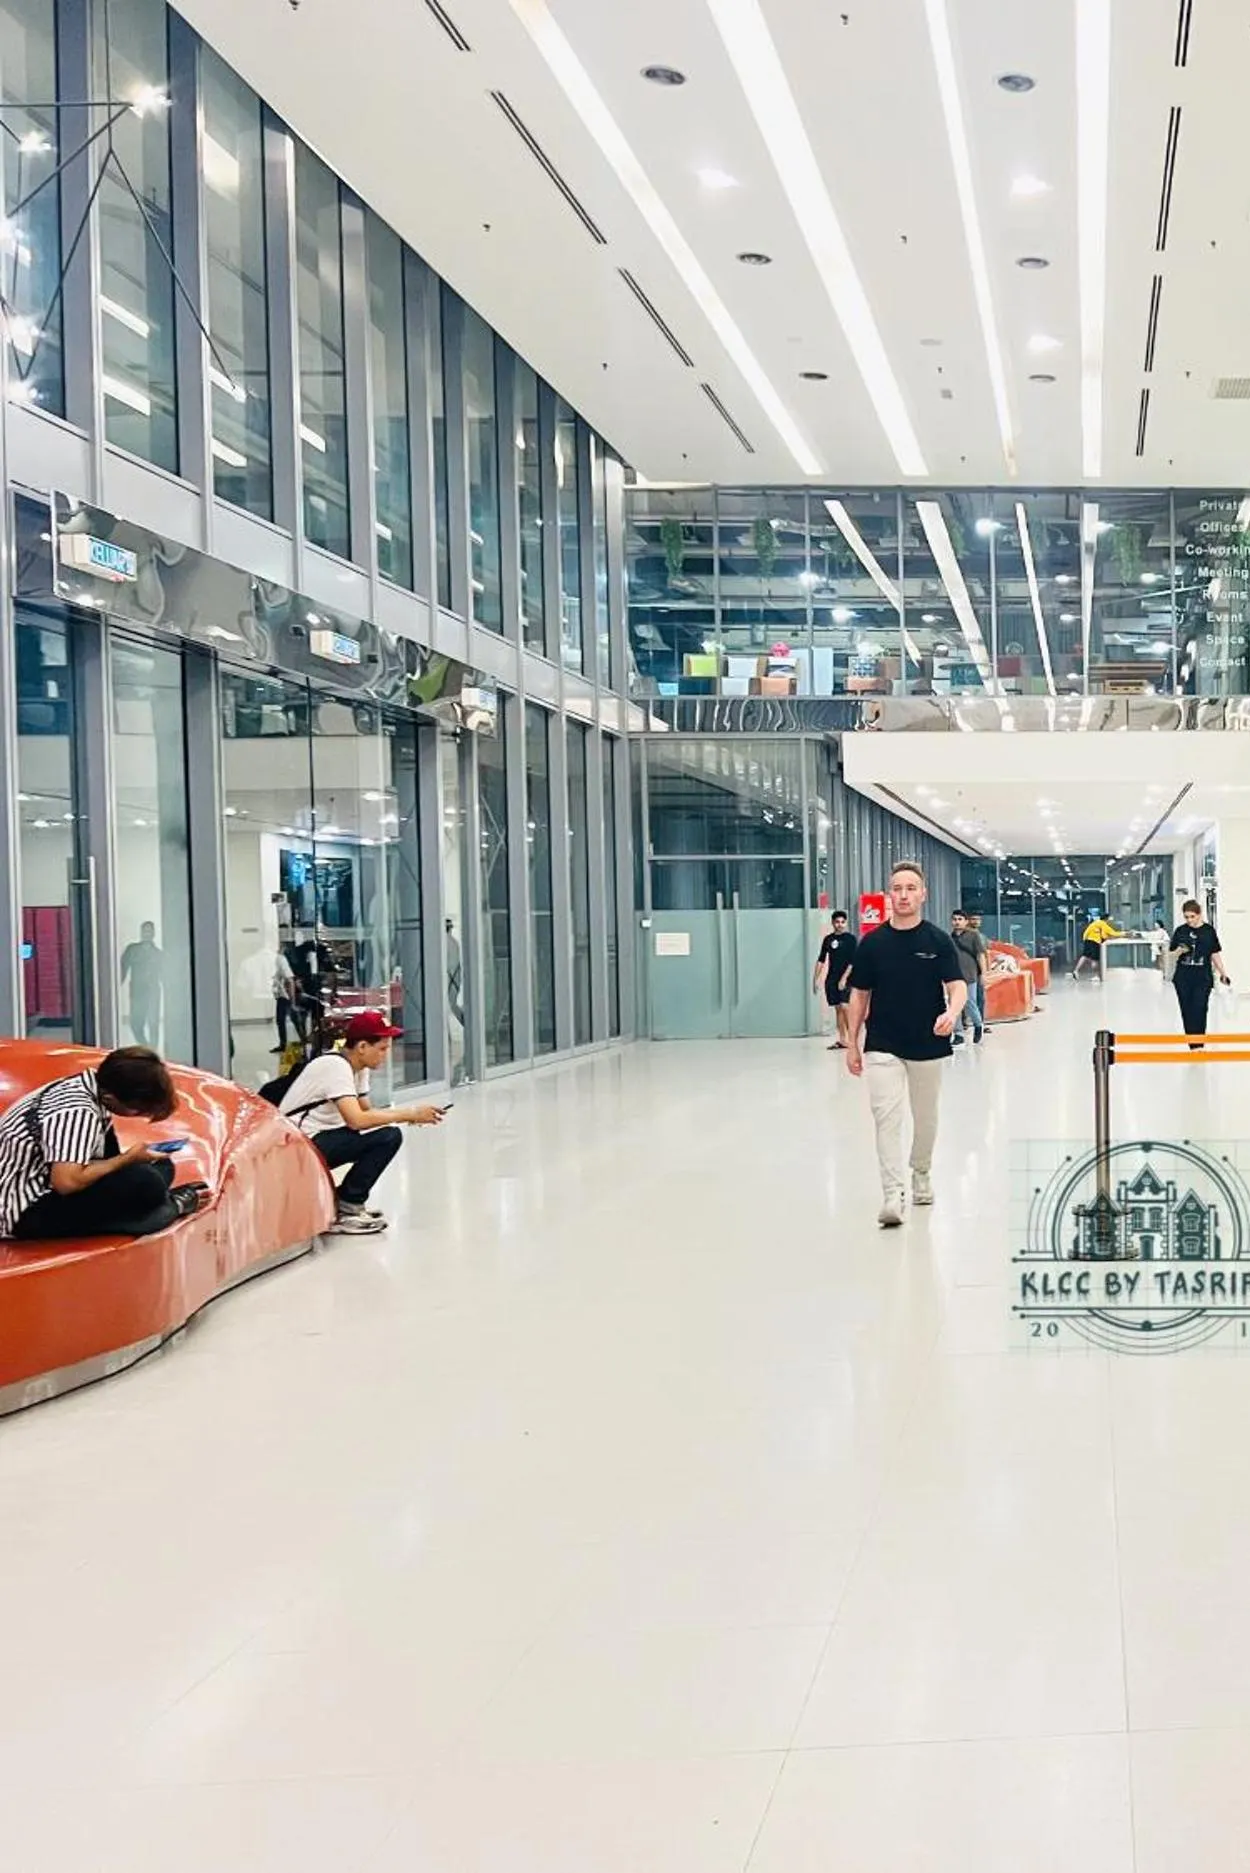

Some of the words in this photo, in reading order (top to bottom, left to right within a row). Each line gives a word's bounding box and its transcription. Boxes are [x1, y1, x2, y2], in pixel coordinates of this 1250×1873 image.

[1200, 521, 1246, 533] Offices
[1198, 566, 1249, 581] Meeting
[1202, 589, 1249, 600] Roms
[1206, 611, 1244, 623] Event
